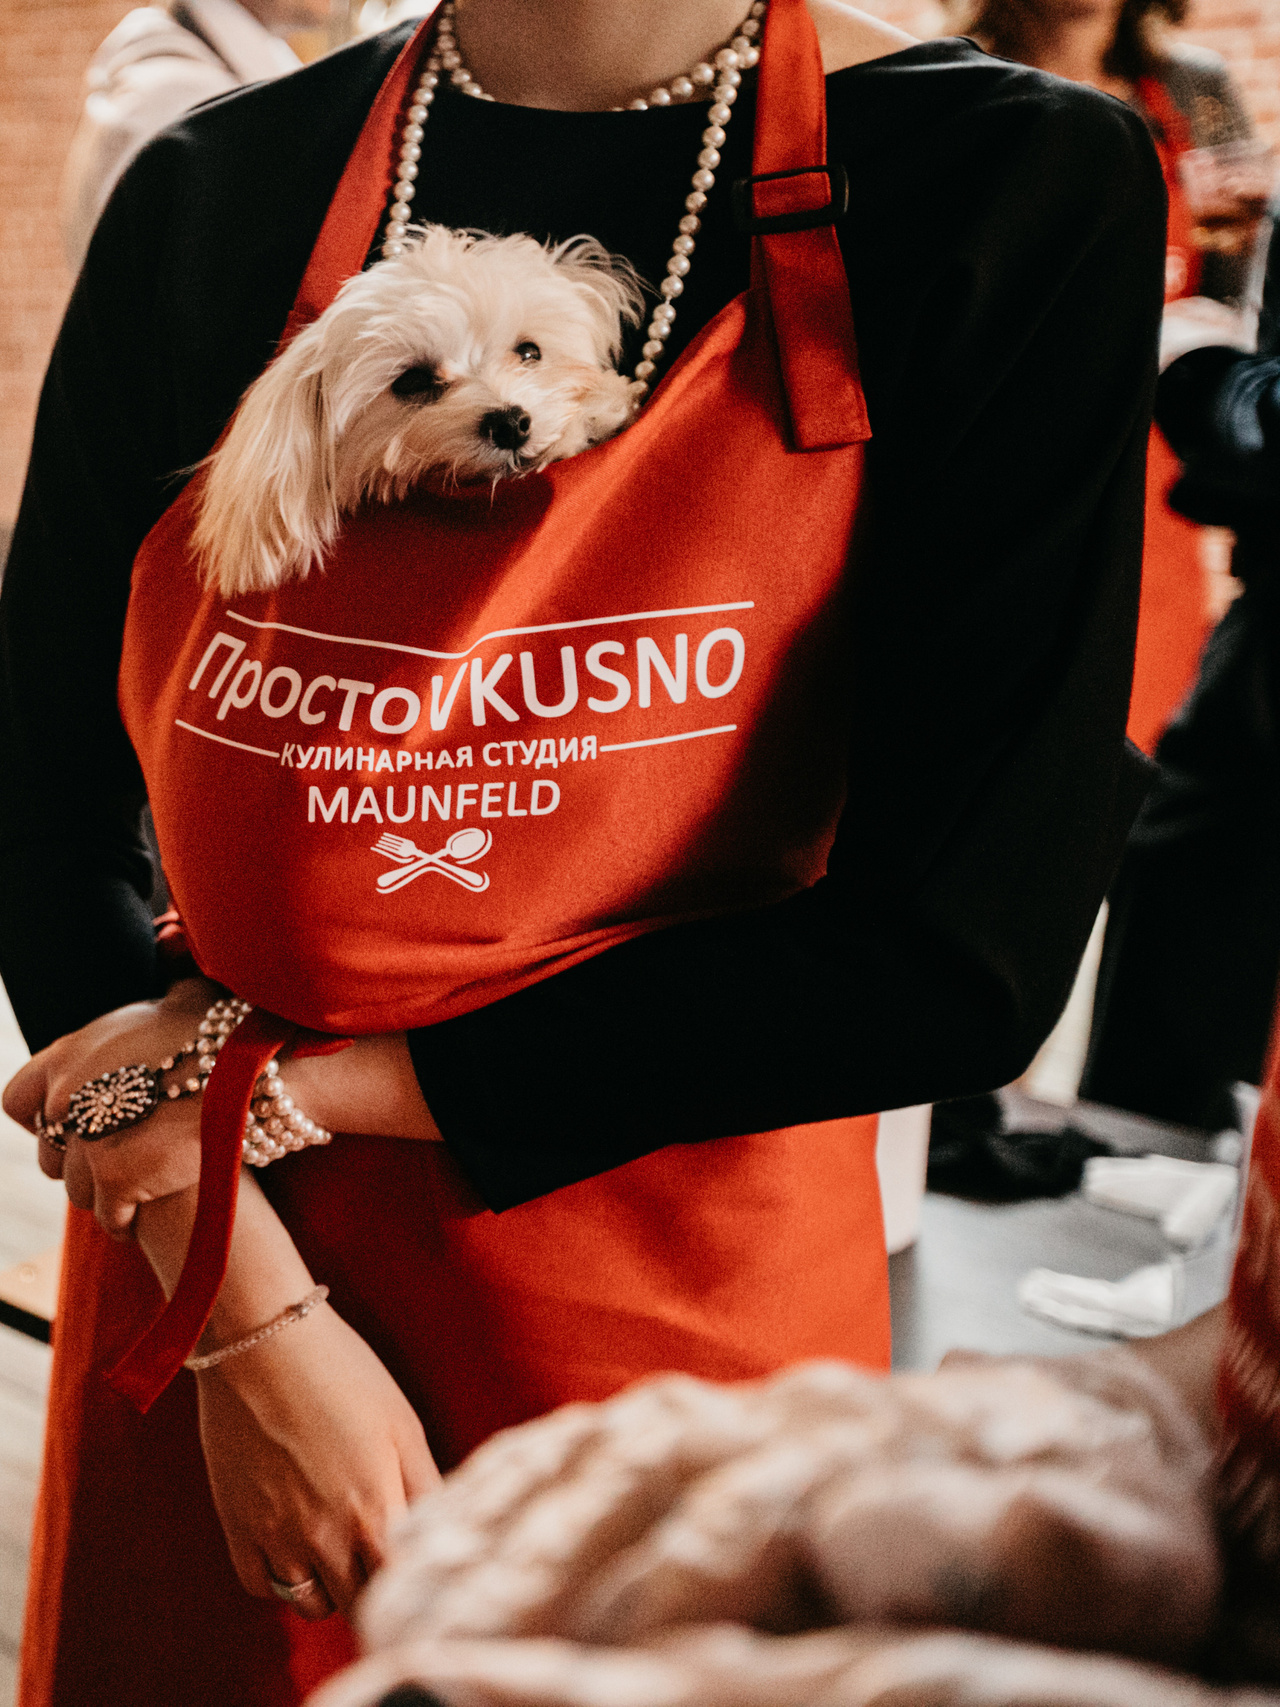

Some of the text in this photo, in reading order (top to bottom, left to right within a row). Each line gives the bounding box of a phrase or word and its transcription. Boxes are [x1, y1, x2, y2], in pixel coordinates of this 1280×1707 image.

[280, 735, 598, 773] КУЛИНАРНАЯ СТУДИЯ
[307, 779, 561, 824] MAUNFELD
